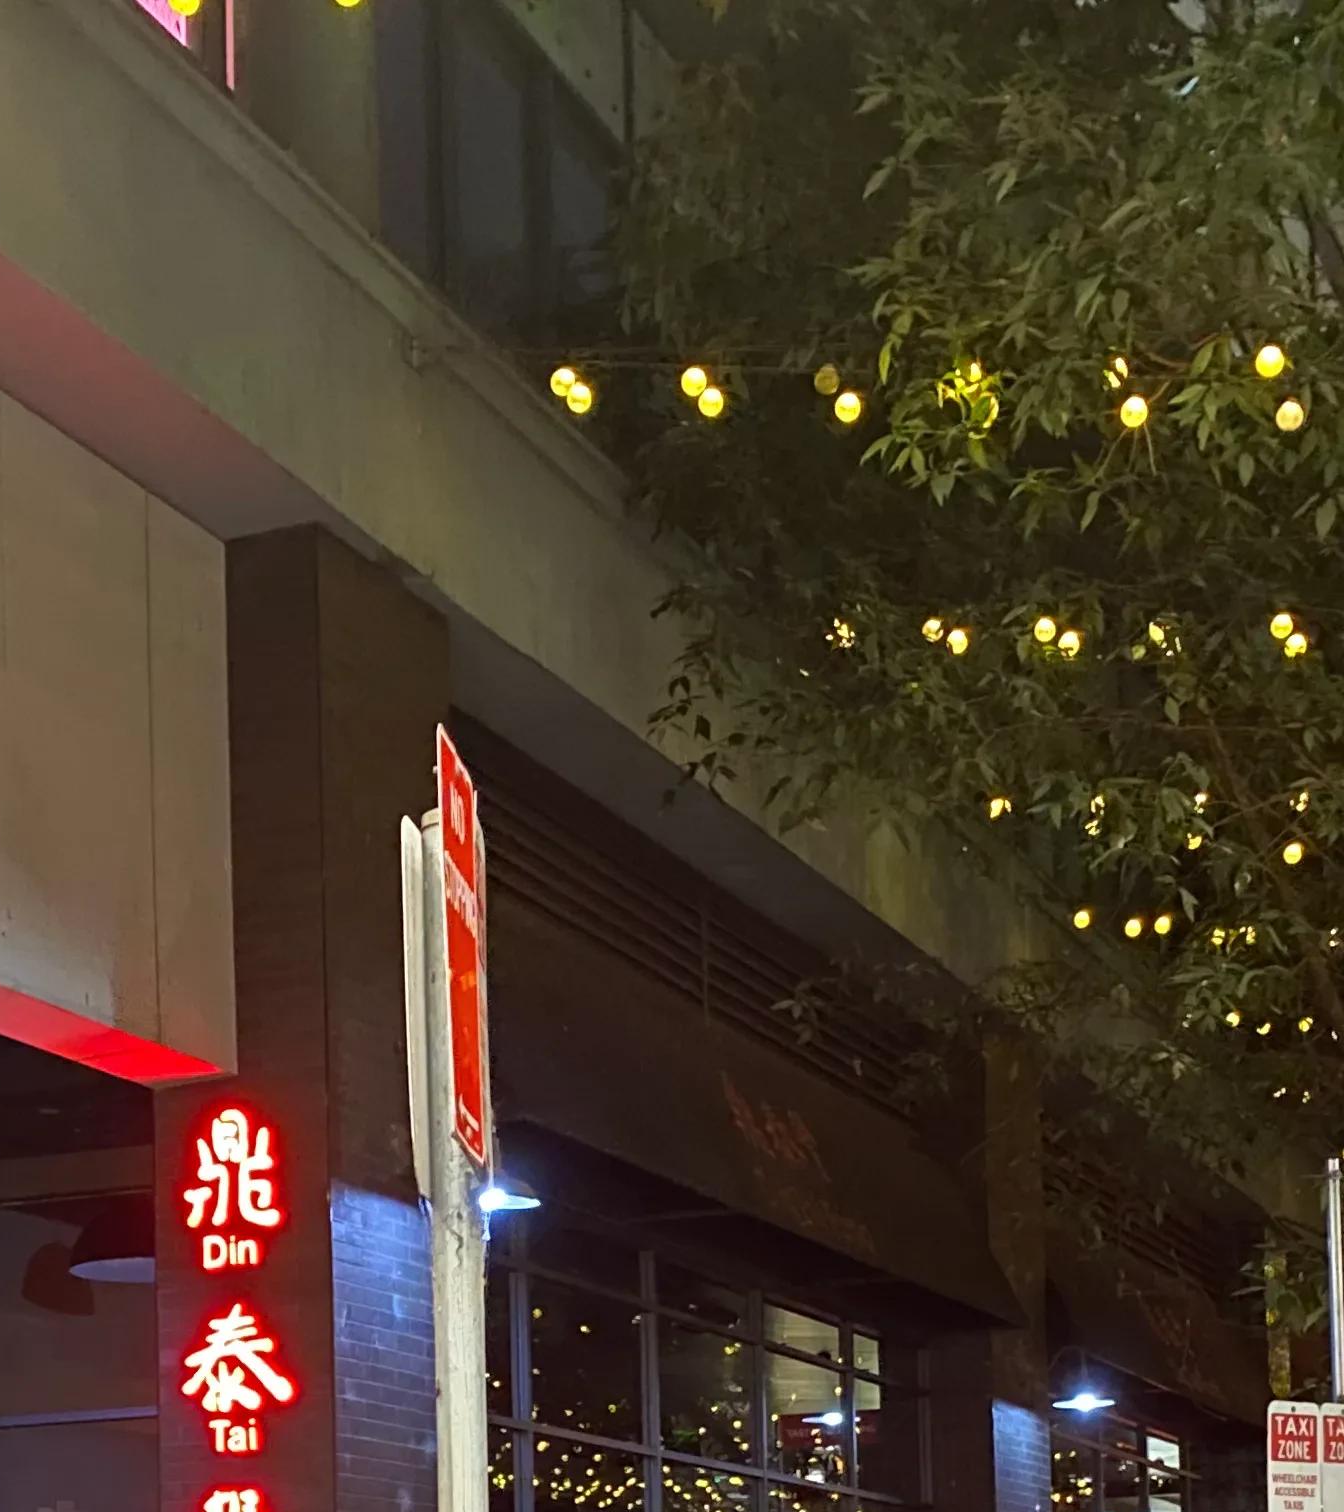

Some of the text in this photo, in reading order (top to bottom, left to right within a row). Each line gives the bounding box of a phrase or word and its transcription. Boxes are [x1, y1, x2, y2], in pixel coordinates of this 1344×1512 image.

[449, 781, 466, 846] NO
[184, 1108, 281, 1228] 鼎
[202, 1236, 258, 1269] Din
[182, 1304, 294, 1412] 泰
[209, 1418, 258, 1452] Tai
[1275, 1416, 1314, 1436] TAXI
[1277, 1439, 1312, 1460] ZONE
[1274, 1486, 1316, 1498] ACCESSIBLE
